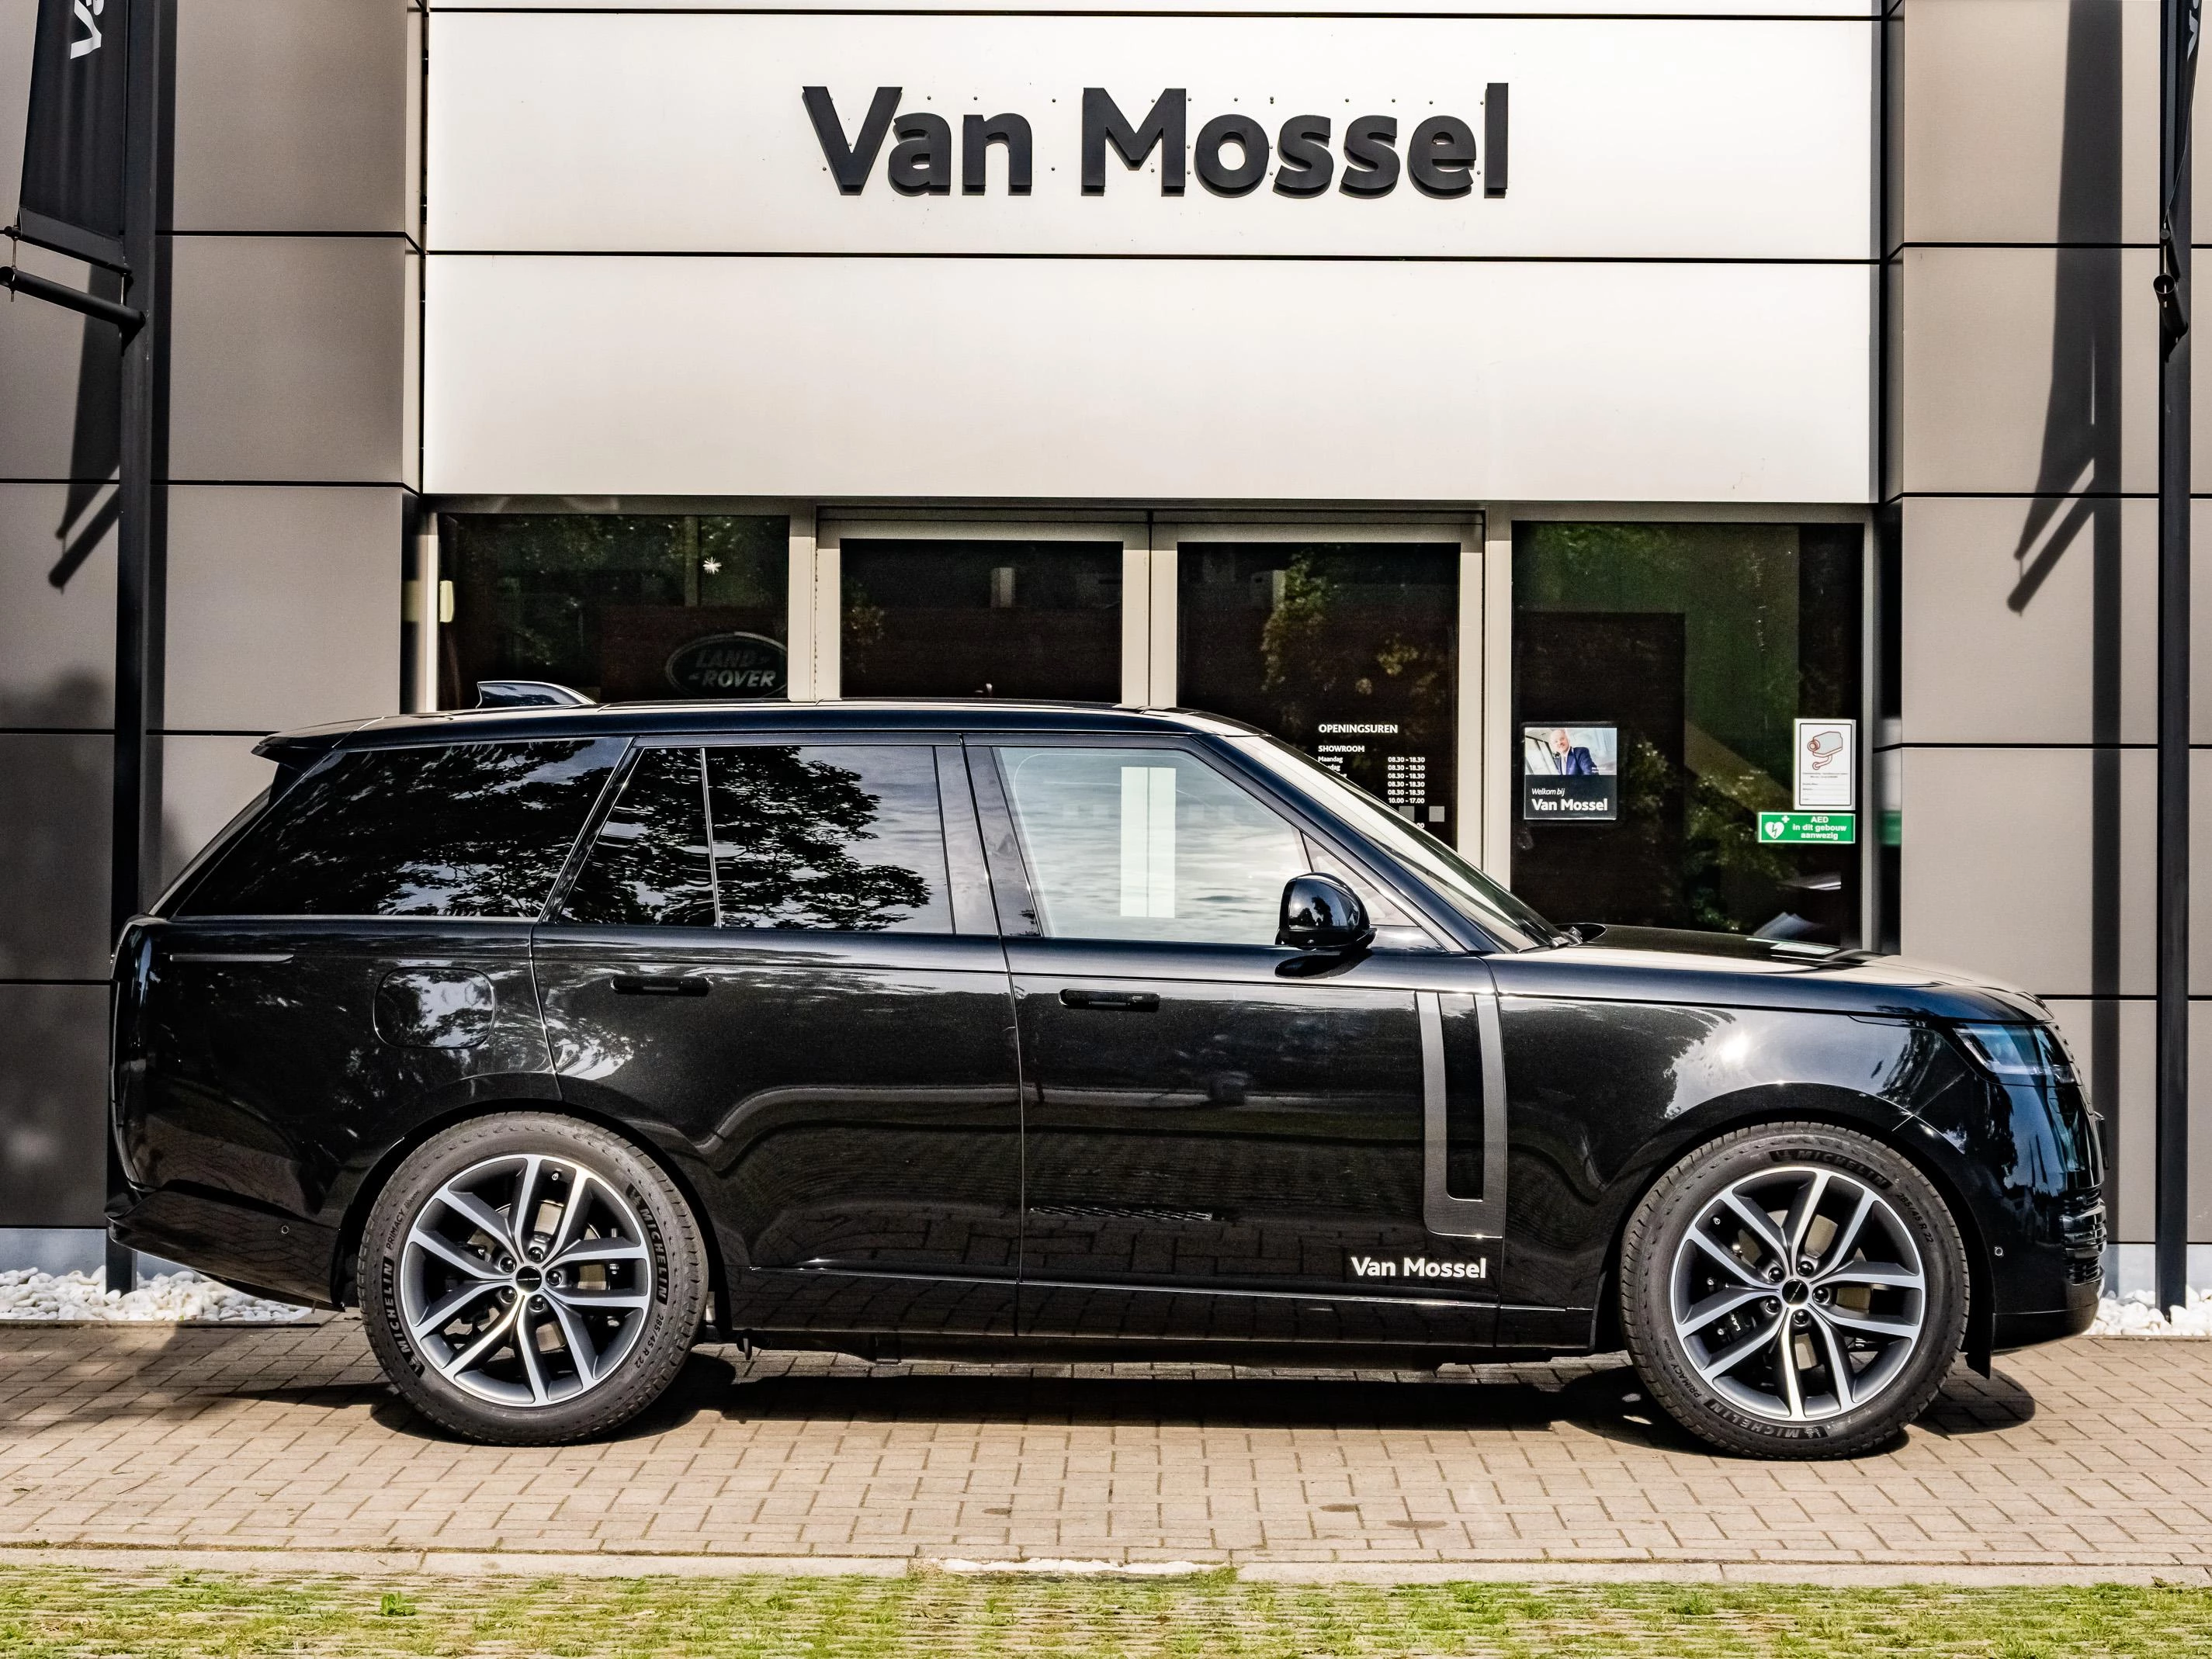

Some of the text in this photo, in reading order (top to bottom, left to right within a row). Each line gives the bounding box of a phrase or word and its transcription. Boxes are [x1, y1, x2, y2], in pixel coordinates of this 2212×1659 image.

[802, 82, 1510, 199] Van Mossel
[702, 670, 776, 687] ROVER
[1318, 724, 1399, 733] OPENINGSUREN
[1531, 798, 1608, 811] Van Mossel
[1556, 788, 1565, 797] bij
[1801, 832, 1839, 840] aanwezig
[1815, 824, 1847, 833] gebouw
[1797, 1150, 1888, 1186] MICHELIN
[386, 1208, 405, 1251] PRIMACY
[640, 1208, 667, 1300] MICHELIN
[1350, 1256, 1487, 1279] Van Mossel
[383, 1262, 411, 1354] MICHELIN
[647, 1312, 664, 1349] 285/45
[634, 1356, 644, 1368] 22
[1671, 1364, 1702, 1398] PRIMACY
[1710, 1402, 1801, 1438] MICHELIN
